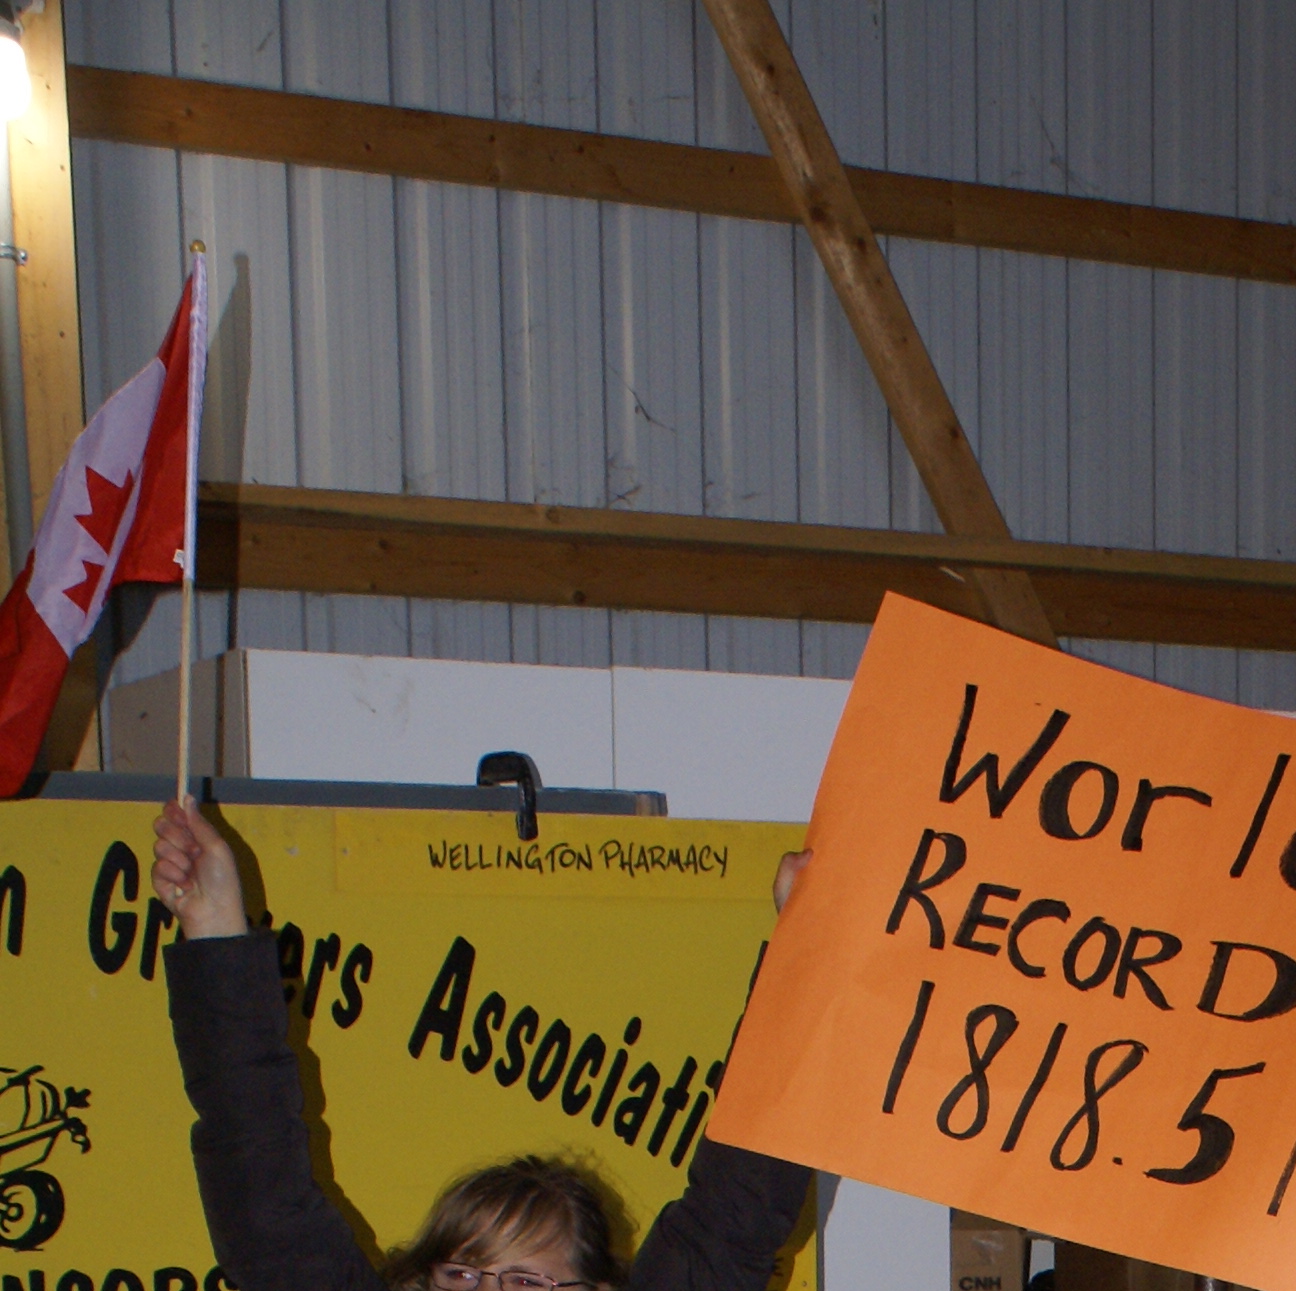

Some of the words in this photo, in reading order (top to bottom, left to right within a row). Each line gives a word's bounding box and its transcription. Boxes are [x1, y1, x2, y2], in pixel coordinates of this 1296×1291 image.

[428, 840, 592, 875] WELLINGTON
[599, 839, 728, 878] PHARMACY
[88, 840, 374, 1029] Grers
[882, 979, 1266, 1185] 1818.5
[959, 1276, 1002, 1291] CNH
